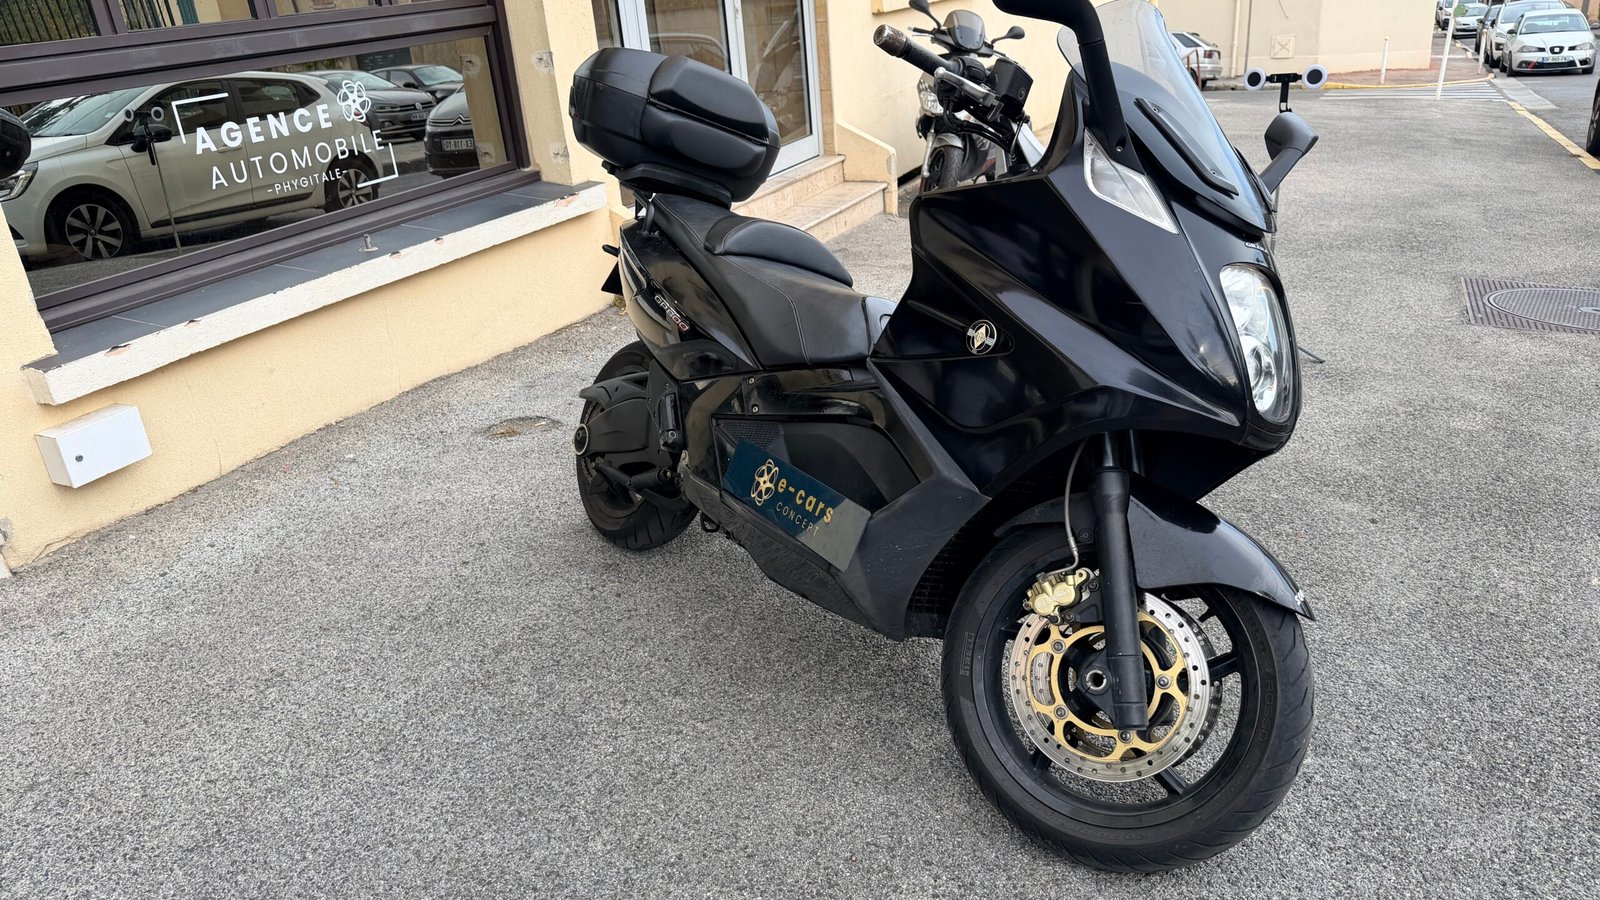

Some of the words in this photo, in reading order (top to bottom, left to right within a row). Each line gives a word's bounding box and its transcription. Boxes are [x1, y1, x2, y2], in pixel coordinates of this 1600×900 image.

[196, 104, 333, 155] AGENCE
[211, 129, 385, 190] AUTOMOBILE
[775, 501, 820, 537] CONCEPT
[777, 478, 834, 524] e-cars
